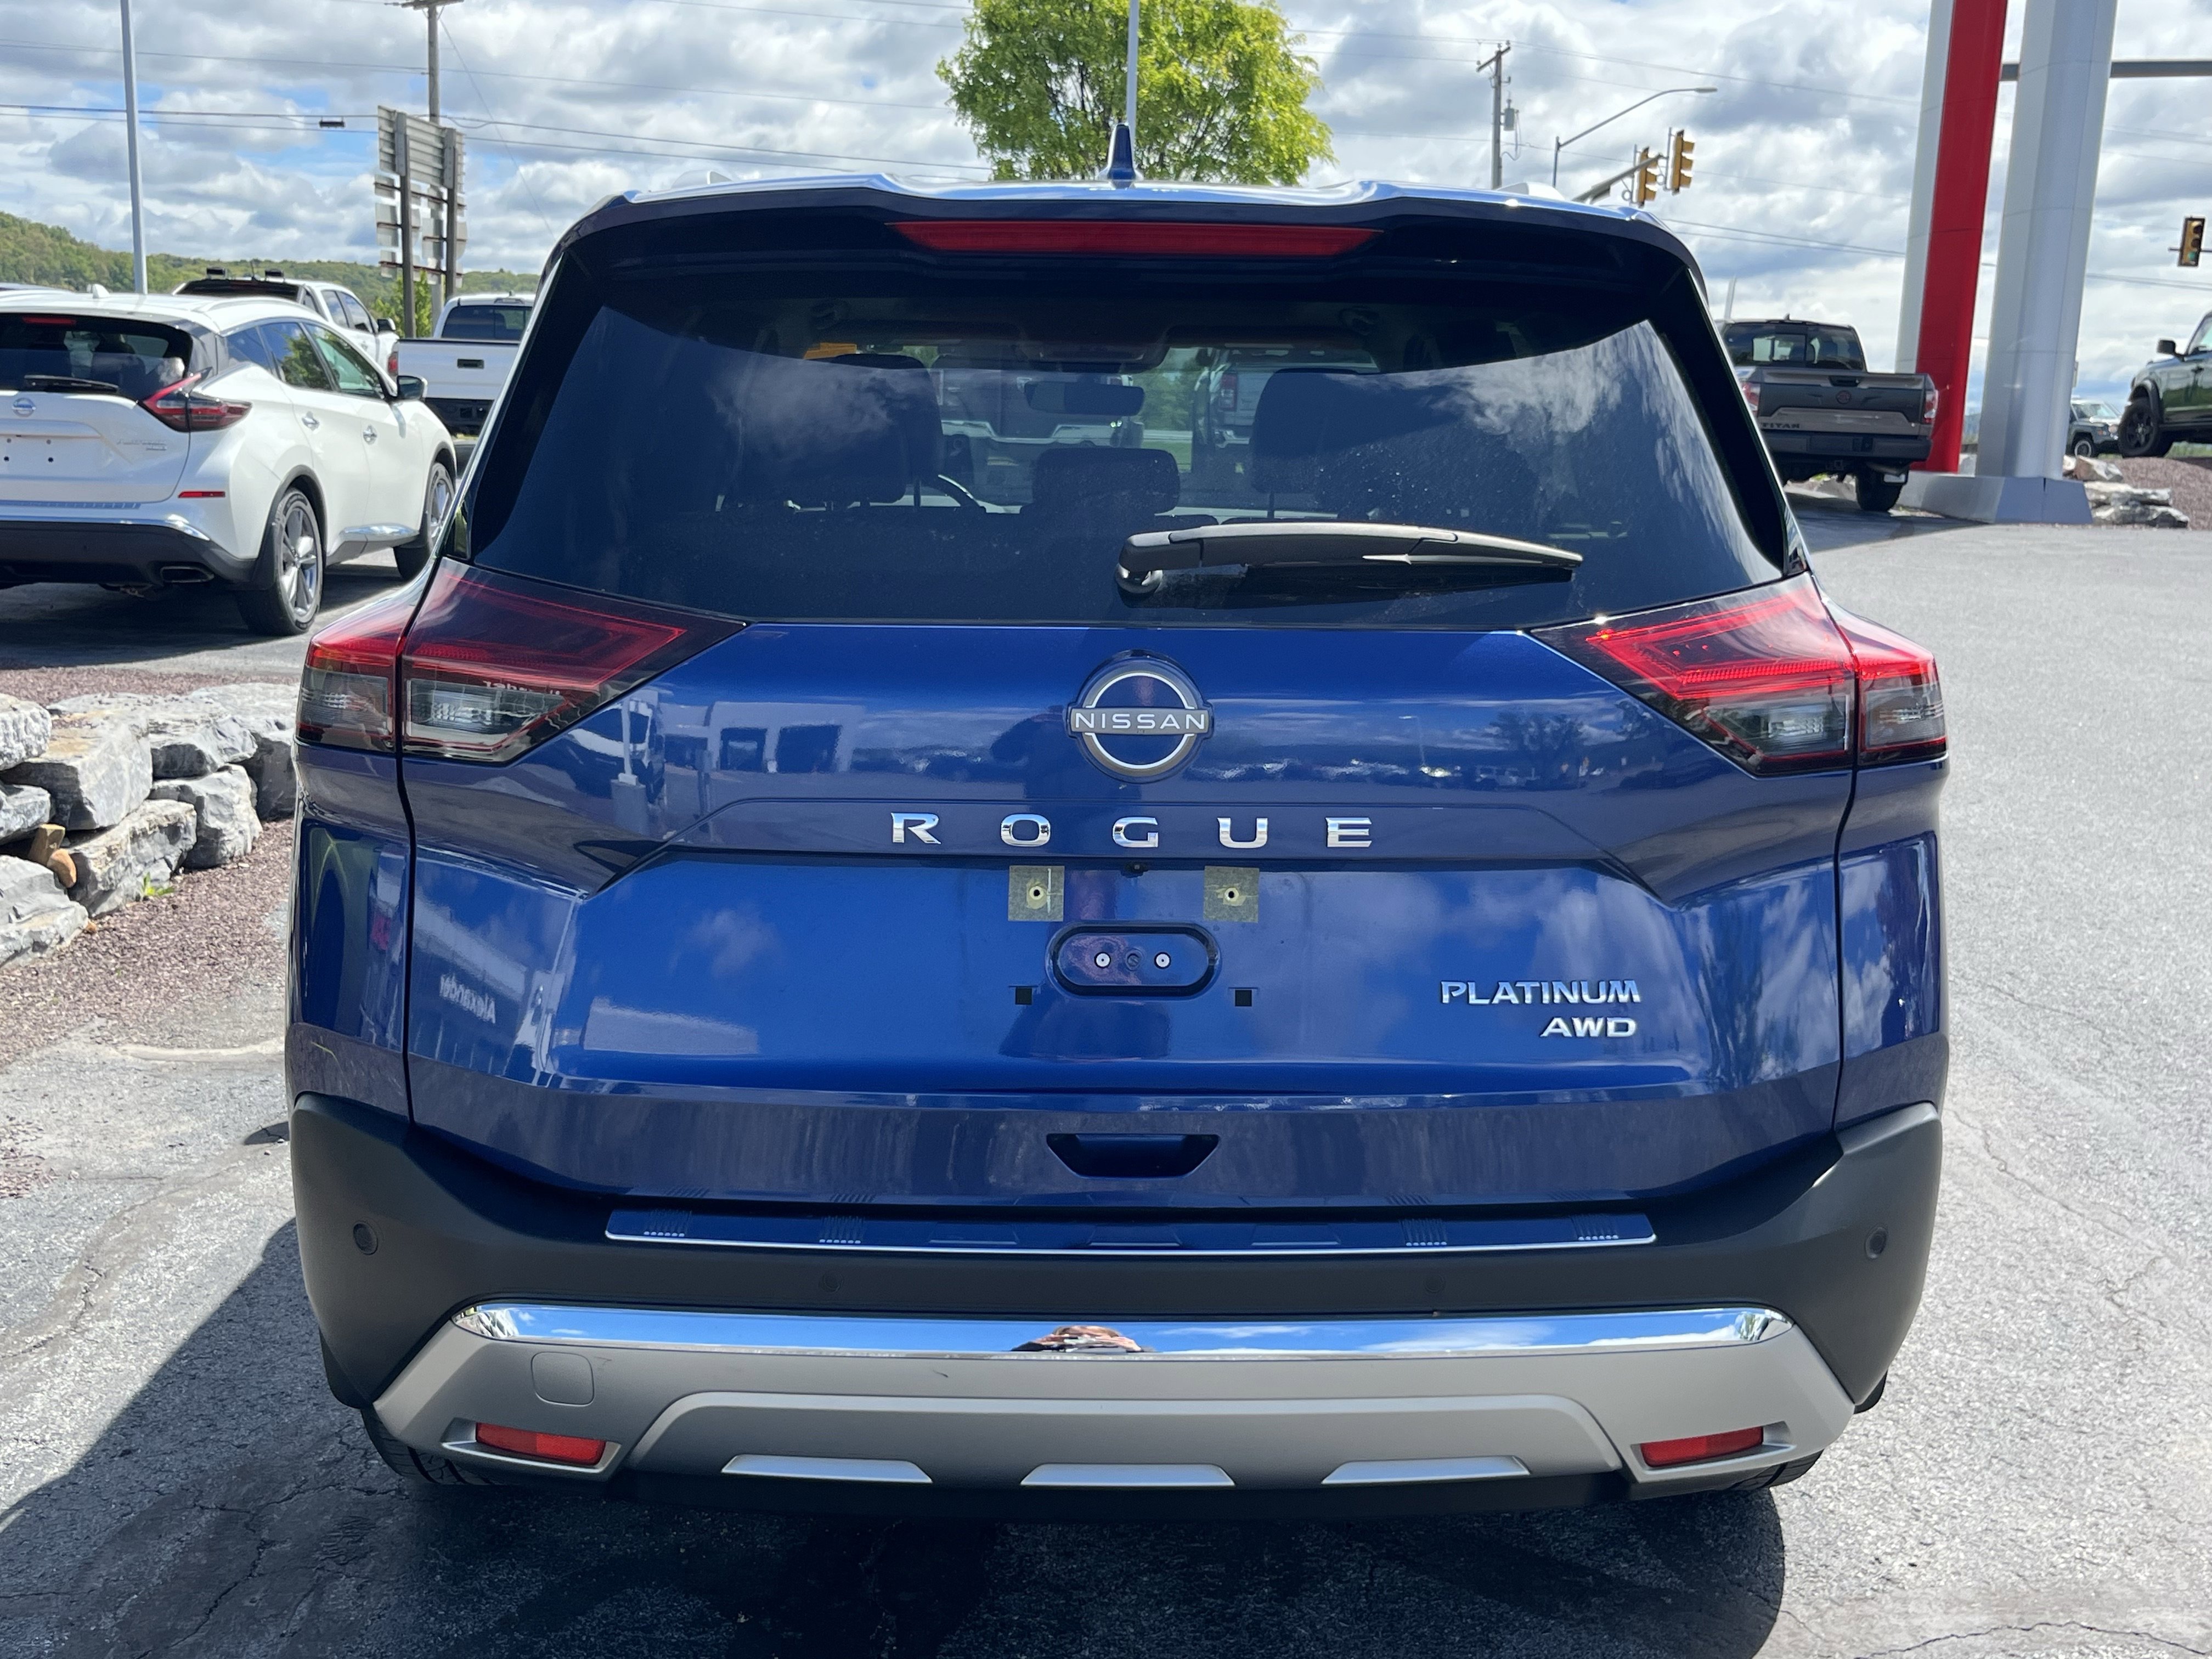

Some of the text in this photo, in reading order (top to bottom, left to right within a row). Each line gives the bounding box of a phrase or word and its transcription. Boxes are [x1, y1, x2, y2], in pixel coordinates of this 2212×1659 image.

[1075, 712, 1205, 730] NISSAN
[891, 811, 1372, 848] ROGUE
[1441, 980, 1641, 1005] PLATINUM
[1539, 1017, 1637, 1038] AWD
